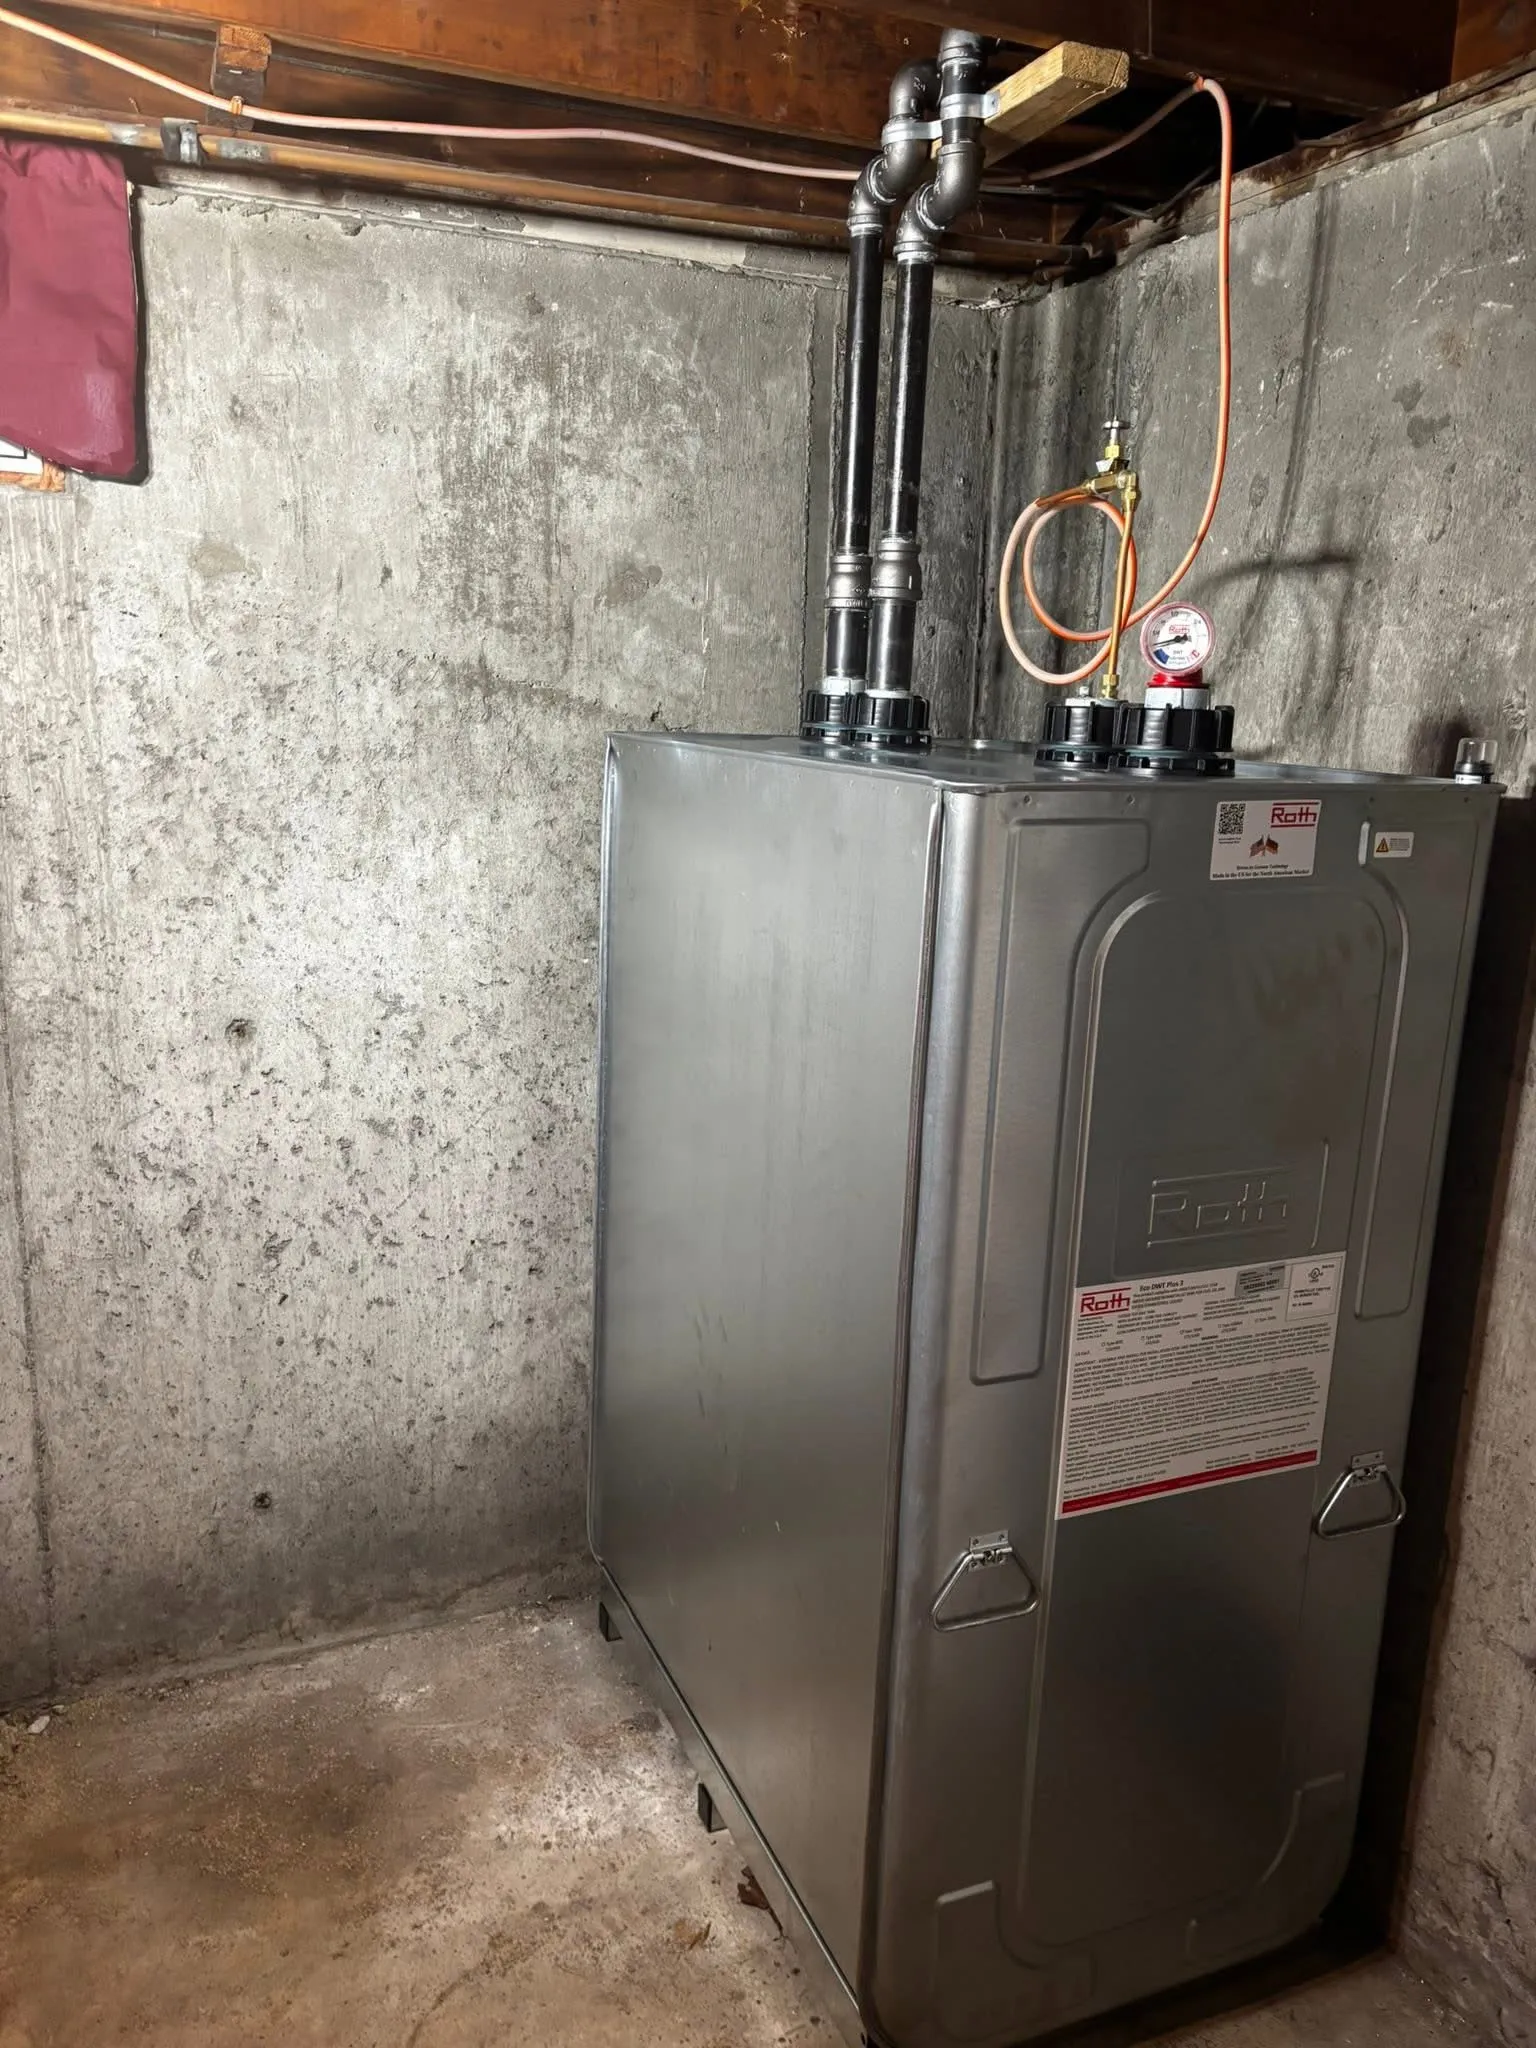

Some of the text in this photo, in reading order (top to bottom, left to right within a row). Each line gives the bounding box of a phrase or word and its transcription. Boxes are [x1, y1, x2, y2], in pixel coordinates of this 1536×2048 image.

[1271, 806, 1317, 823] Roth
[1166, 1280, 1179, 1288] Plus
[1081, 1293, 1130, 1312] Roth
